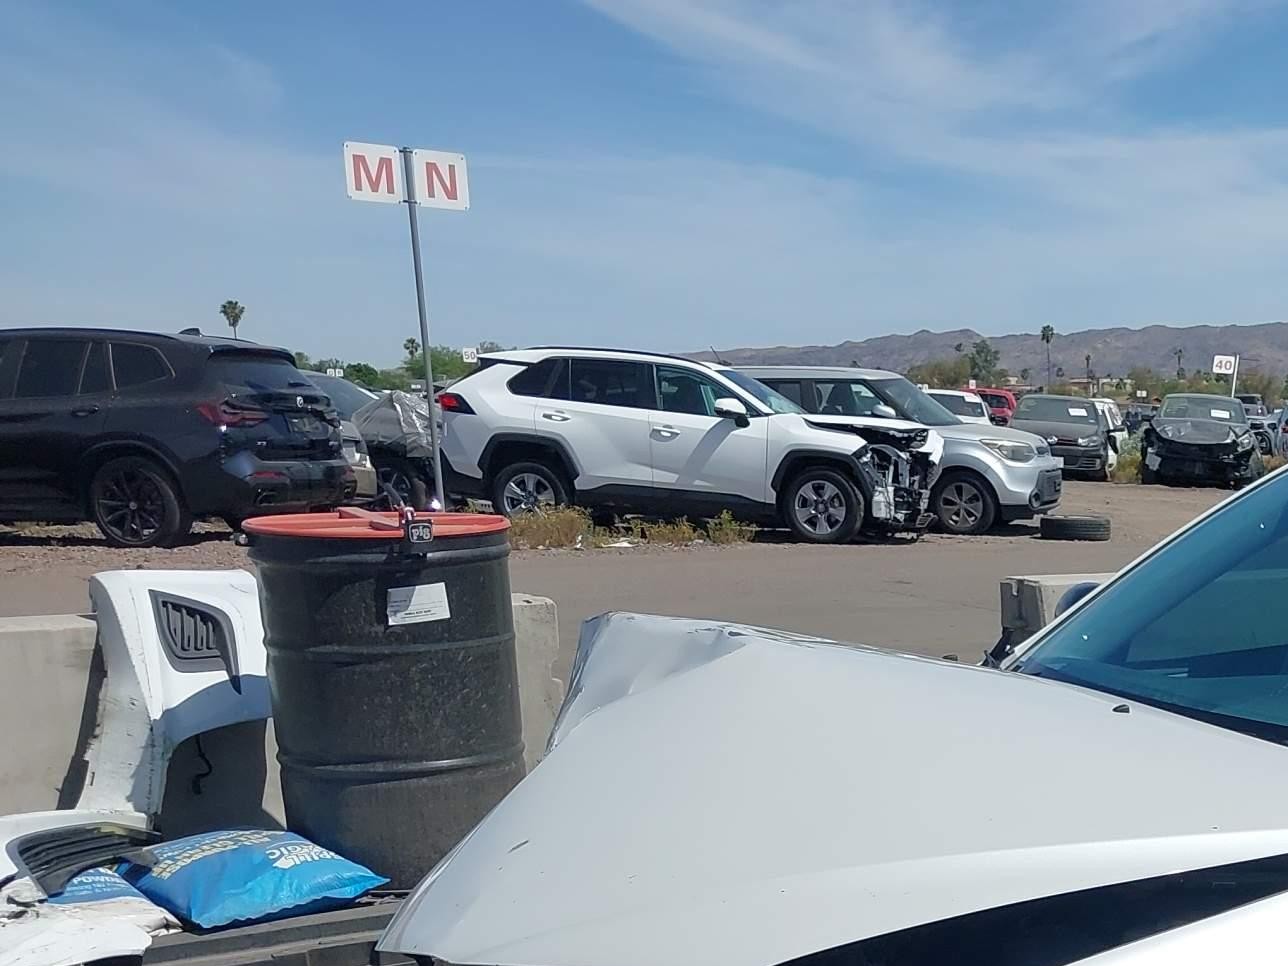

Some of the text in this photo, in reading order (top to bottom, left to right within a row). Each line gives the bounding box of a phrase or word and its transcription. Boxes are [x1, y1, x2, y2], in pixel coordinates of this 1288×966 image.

[352, 154, 395, 194] M
[425, 161, 458, 200] N
[464, 351, 476, 360] 50
[1216, 360, 1232, 370] 40
[412, 526, 430, 540] pig
